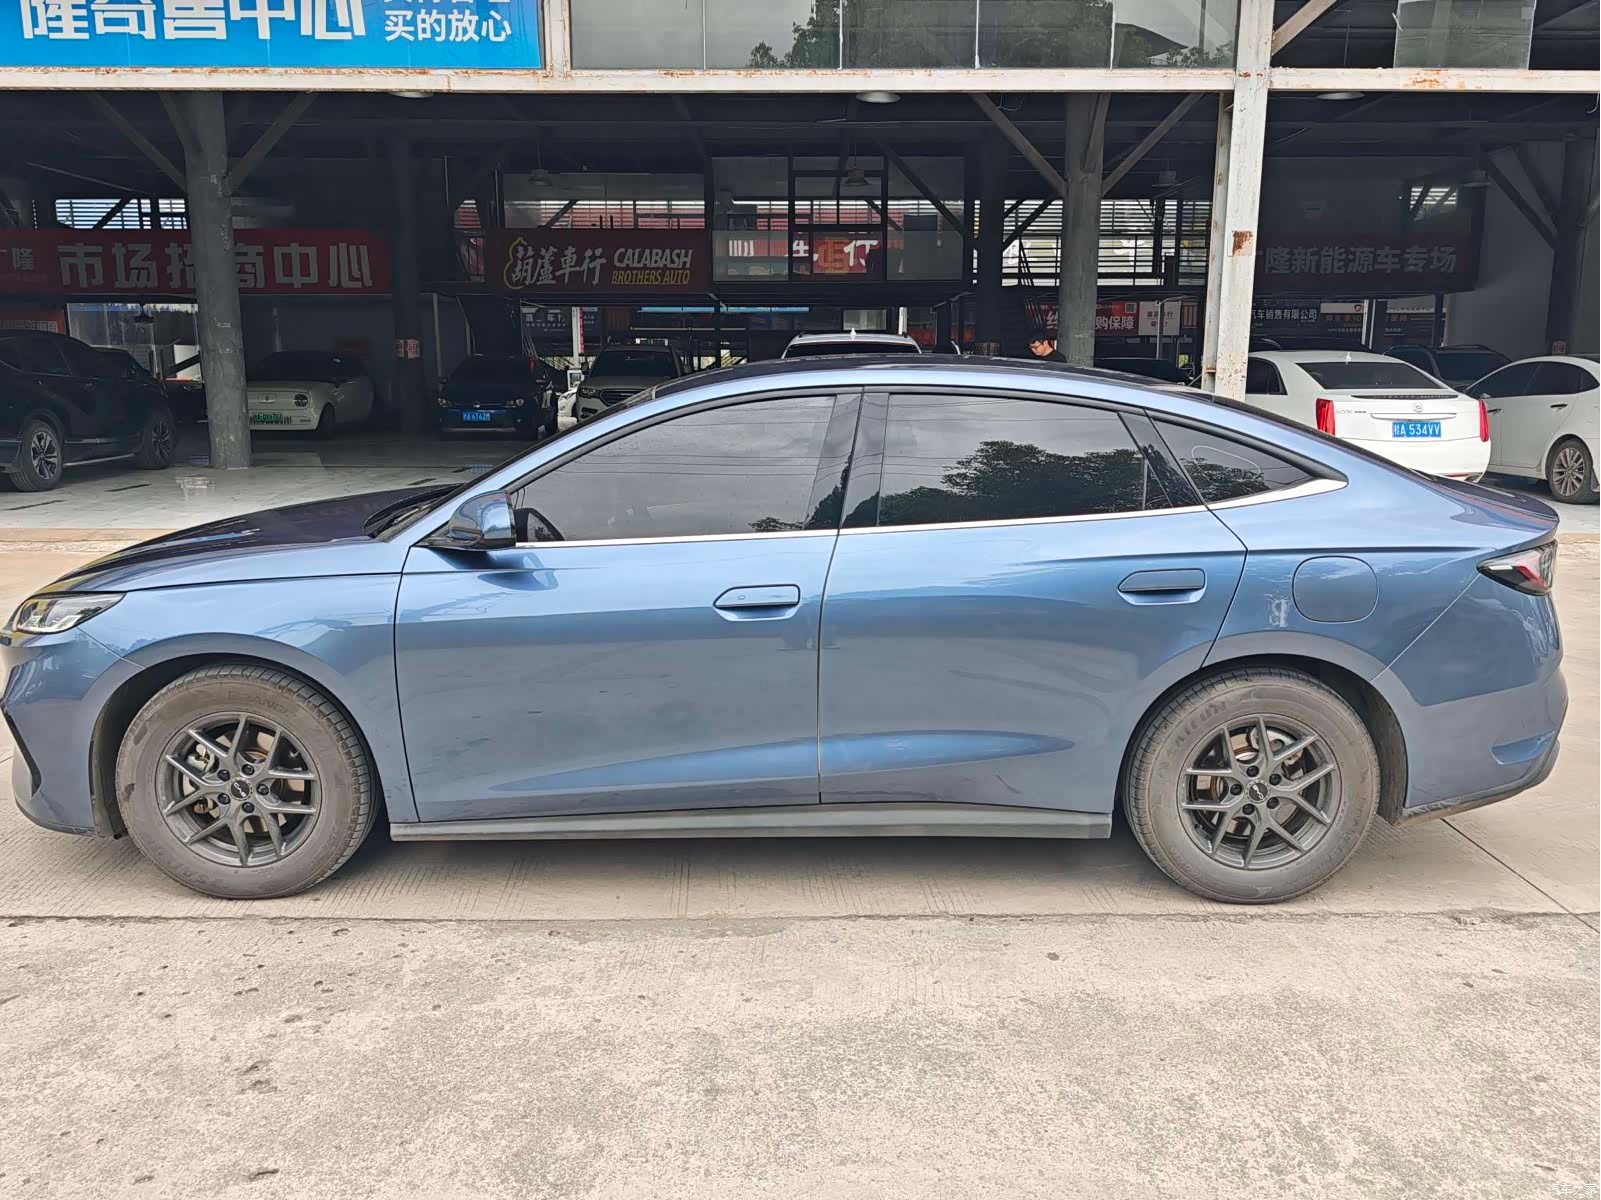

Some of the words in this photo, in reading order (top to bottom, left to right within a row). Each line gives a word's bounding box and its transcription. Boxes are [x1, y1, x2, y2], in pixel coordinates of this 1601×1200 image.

[384, 9, 512, 42] 买的放心
[0, 248, 34, 271] 隆
[613, 248, 692, 269] CALABASH
[1257, 246, 1457, 274] 隆新能源车专场
[611, 270, 662, 285] BROTHERS
[665, 270, 690, 284] AUTO
